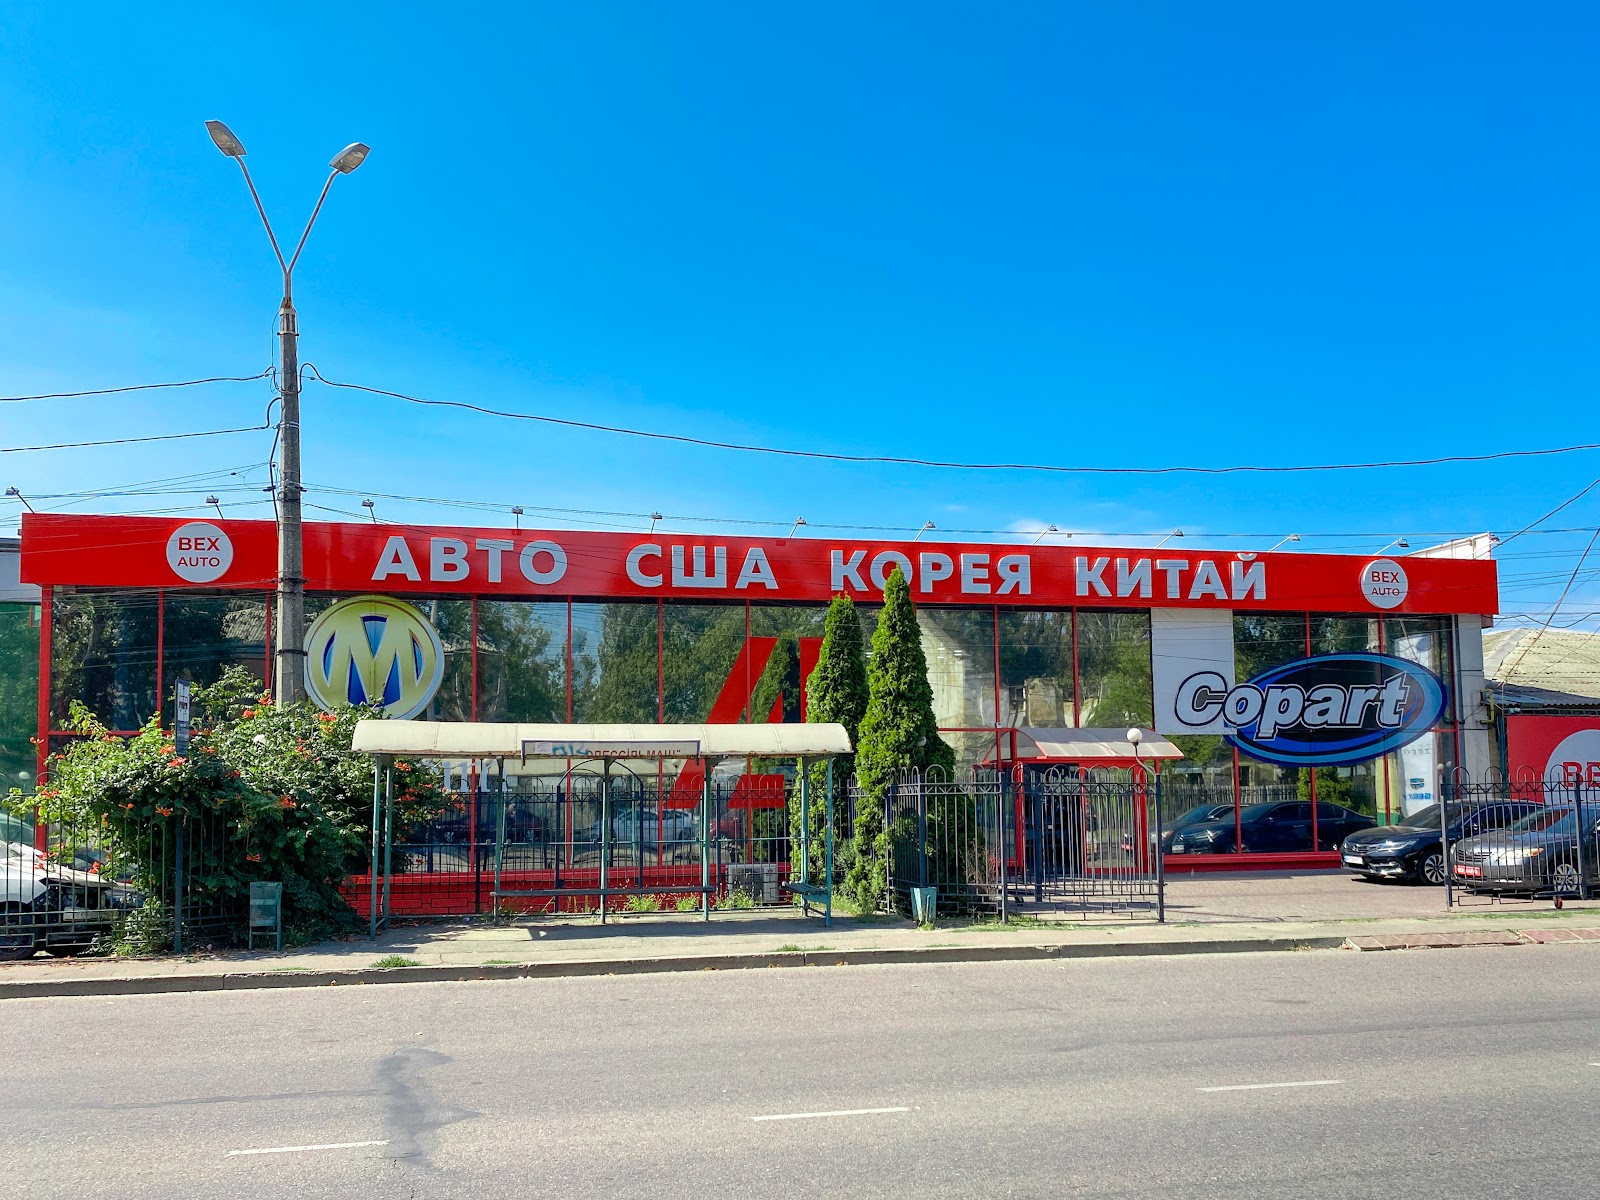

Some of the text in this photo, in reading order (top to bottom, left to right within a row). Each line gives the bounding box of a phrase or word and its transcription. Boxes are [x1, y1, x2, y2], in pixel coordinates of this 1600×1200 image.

[178, 537, 220, 551] BEX
[177, 556, 220, 567] AUTO
[371, 535, 1266, 600] АВТО США КОРЕЯ КИТАЙ
[1371, 571, 1399, 583] BEX
[1371, 587, 1400, 596] AUTO
[1174, 670, 1410, 741] Copart
